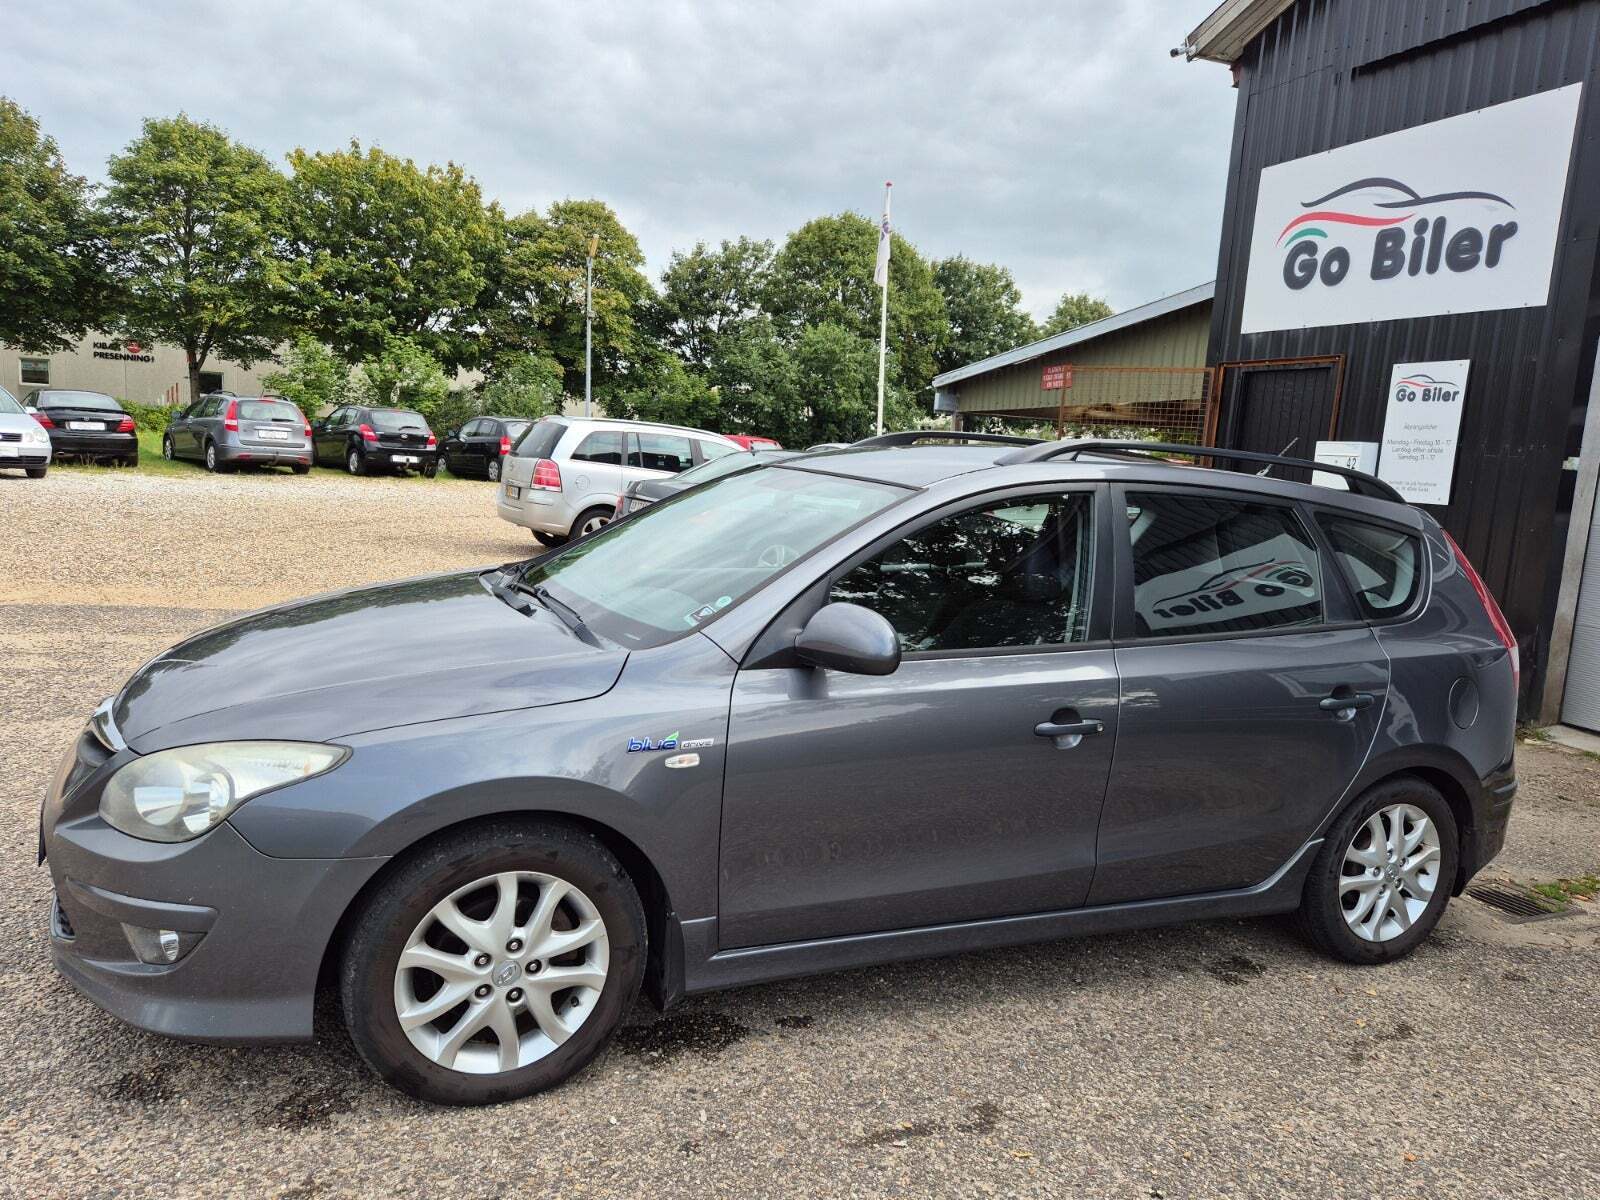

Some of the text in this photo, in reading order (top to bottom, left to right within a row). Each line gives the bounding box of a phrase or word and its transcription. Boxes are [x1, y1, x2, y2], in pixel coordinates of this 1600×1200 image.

[1283, 216, 1518, 290] Go Biler
[1395, 387, 1460, 402] Go Biler
[1346, 457, 1357, 469] 42
[627, 736, 678, 753] blue
